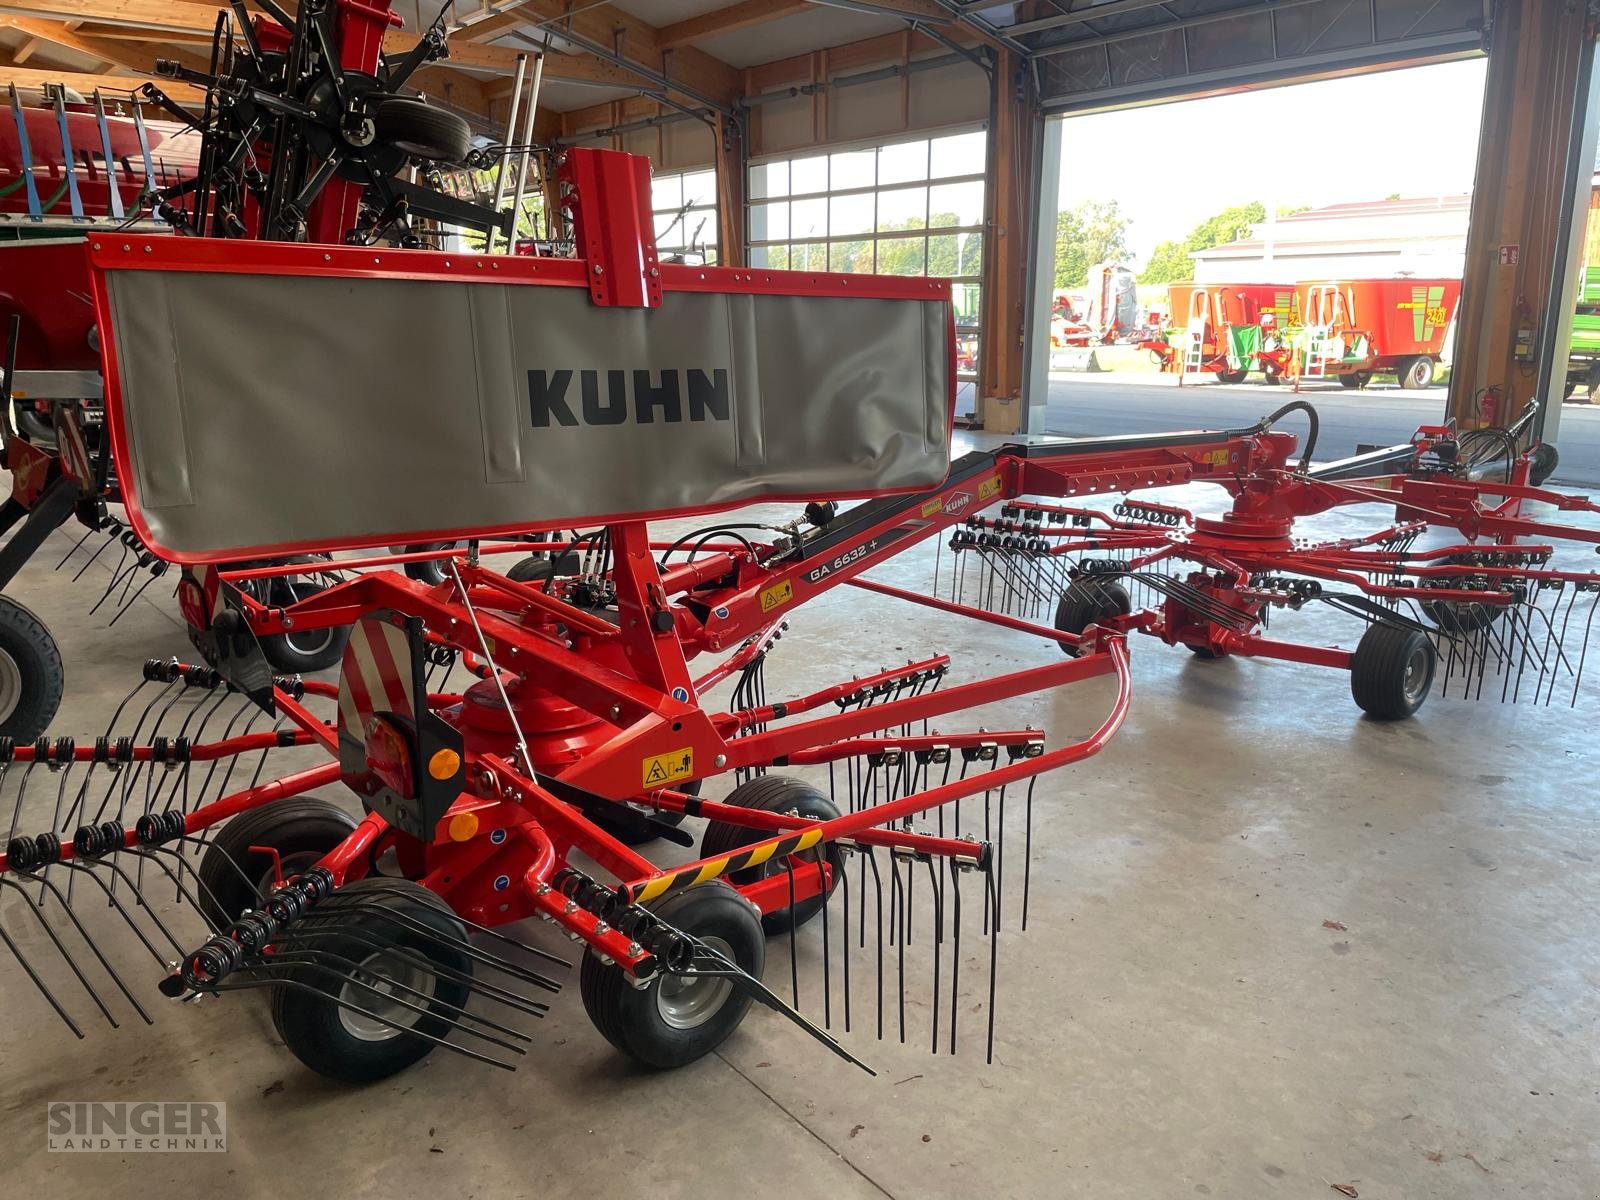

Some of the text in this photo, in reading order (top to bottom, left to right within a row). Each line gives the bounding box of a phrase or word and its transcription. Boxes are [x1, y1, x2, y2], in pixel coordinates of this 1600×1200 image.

[527, 369, 729, 427] KUHN
[945, 494, 970, 513] KUHN
[810, 564, 830, 581] GA
[834, 545, 867, 569] 6632
